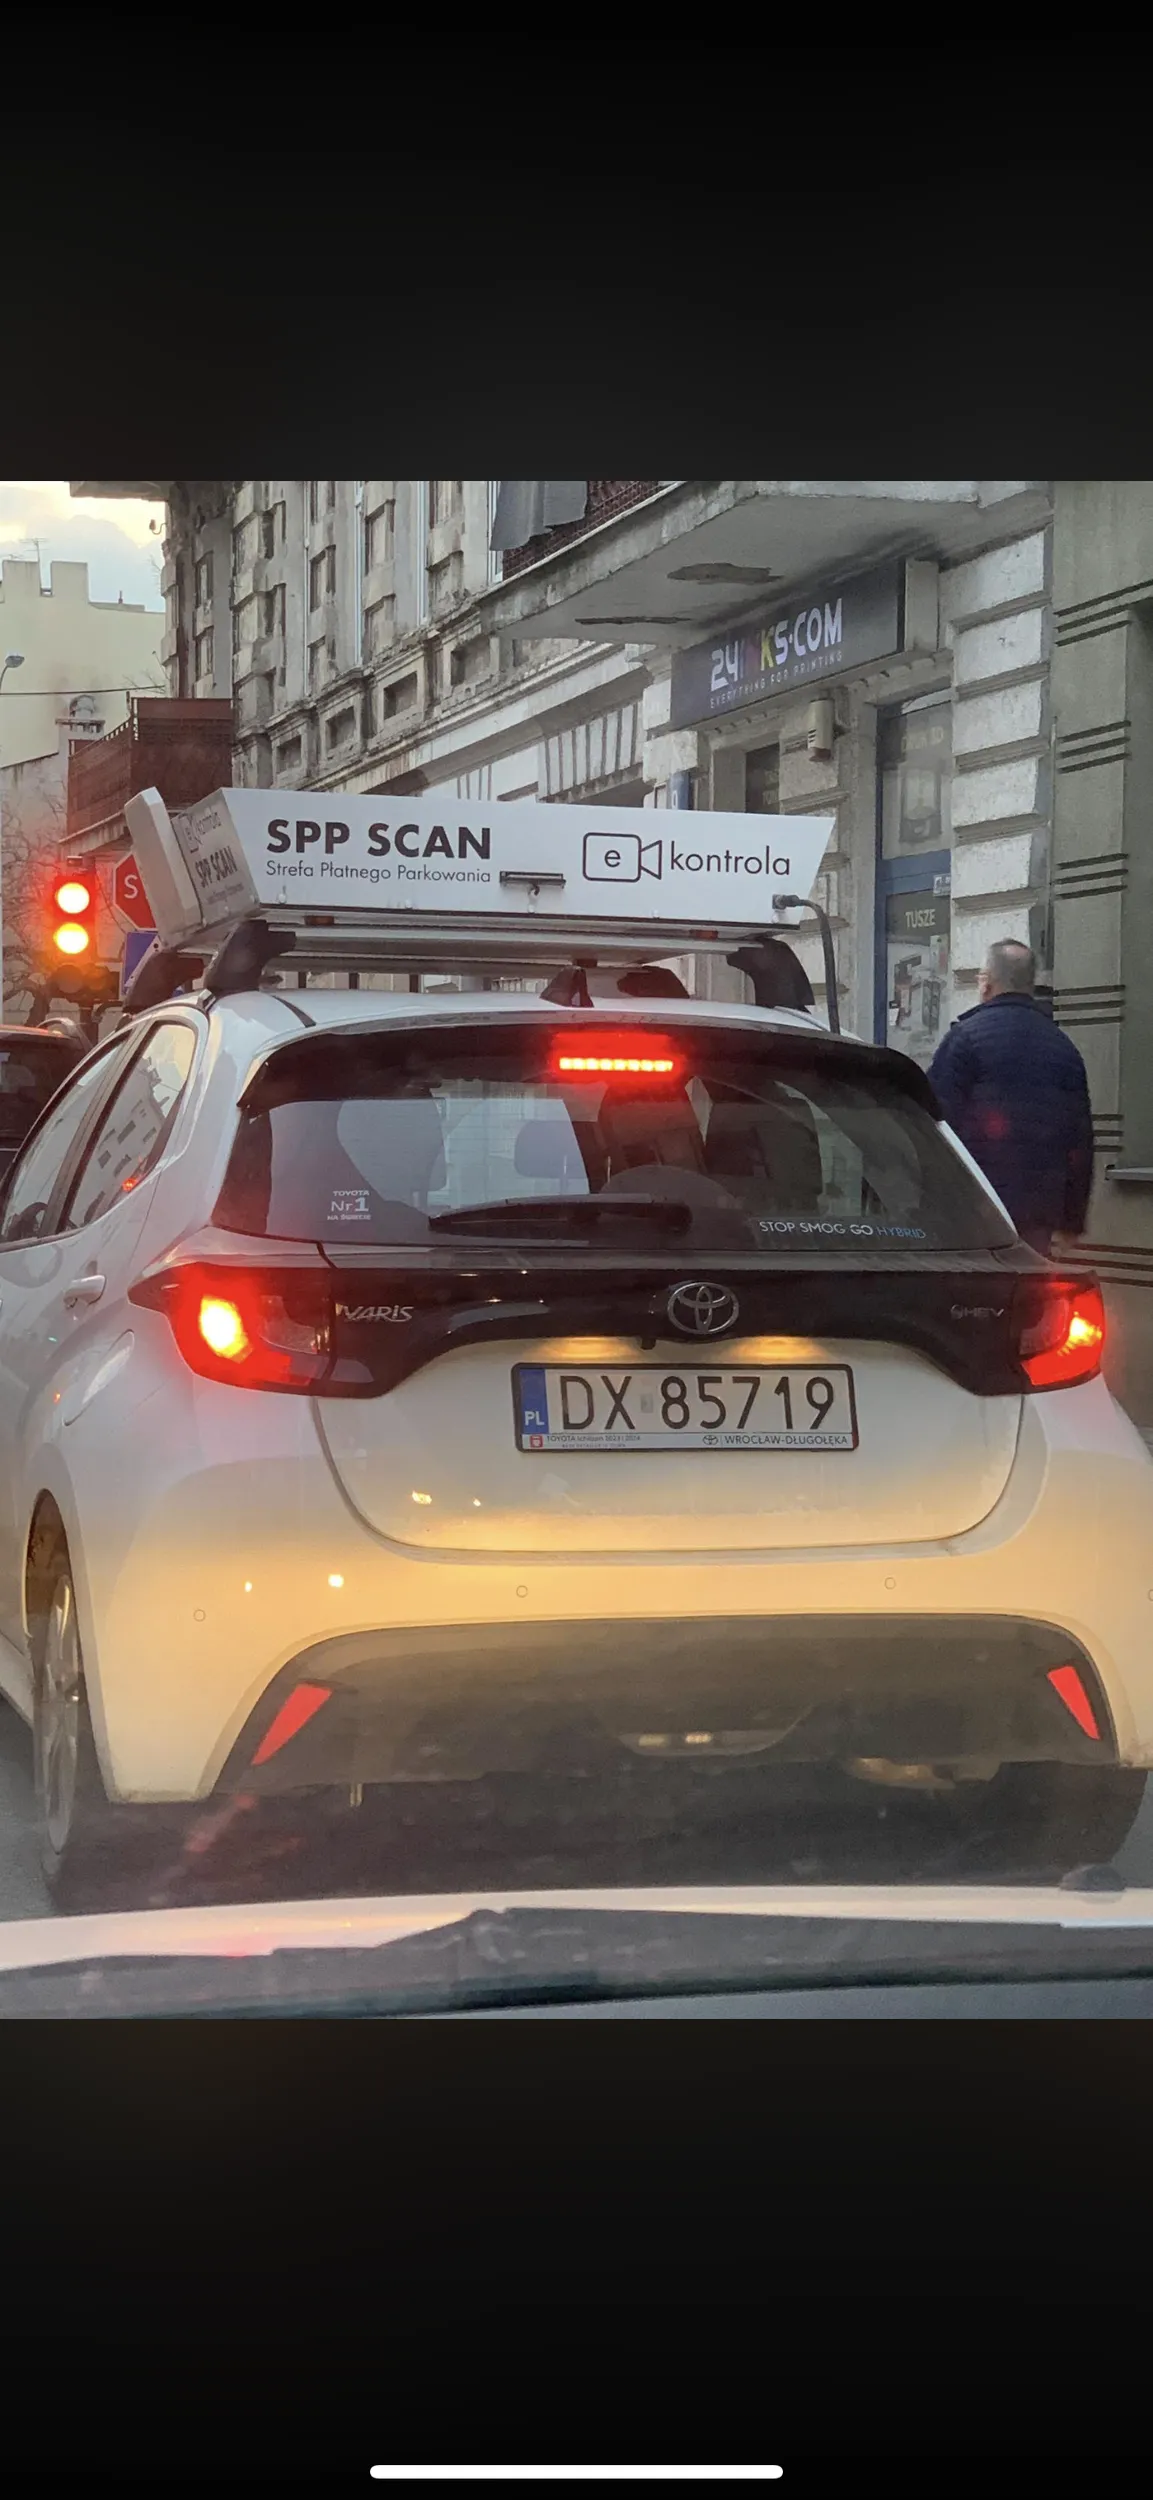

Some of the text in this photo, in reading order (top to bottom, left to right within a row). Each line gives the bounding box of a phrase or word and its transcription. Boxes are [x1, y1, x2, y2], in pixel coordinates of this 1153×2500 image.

[710, 651, 842, 709] EVERYTHING FOR PRINTING
[266, 818, 350, 854] SPP
[367, 822, 491, 860] SCAN
[604, 840, 790, 876] e kontrola
[266, 859, 491, 884] Strefa Płatnego Parkowania
[905, 908, 936, 928] TUSZE
[332, 1189, 370, 1197] TOYOTA
[759, 1221, 927, 1240] STOP SMOG GO HYBRID
[560, 1375, 834, 1430] DX 85719
[524, 1410, 546, 1426] PL
[547, 1434, 576, 1442] TOYOTA
[725, 1435, 847, 1446] WROCŁAW-DŁUGOŁĘKA
